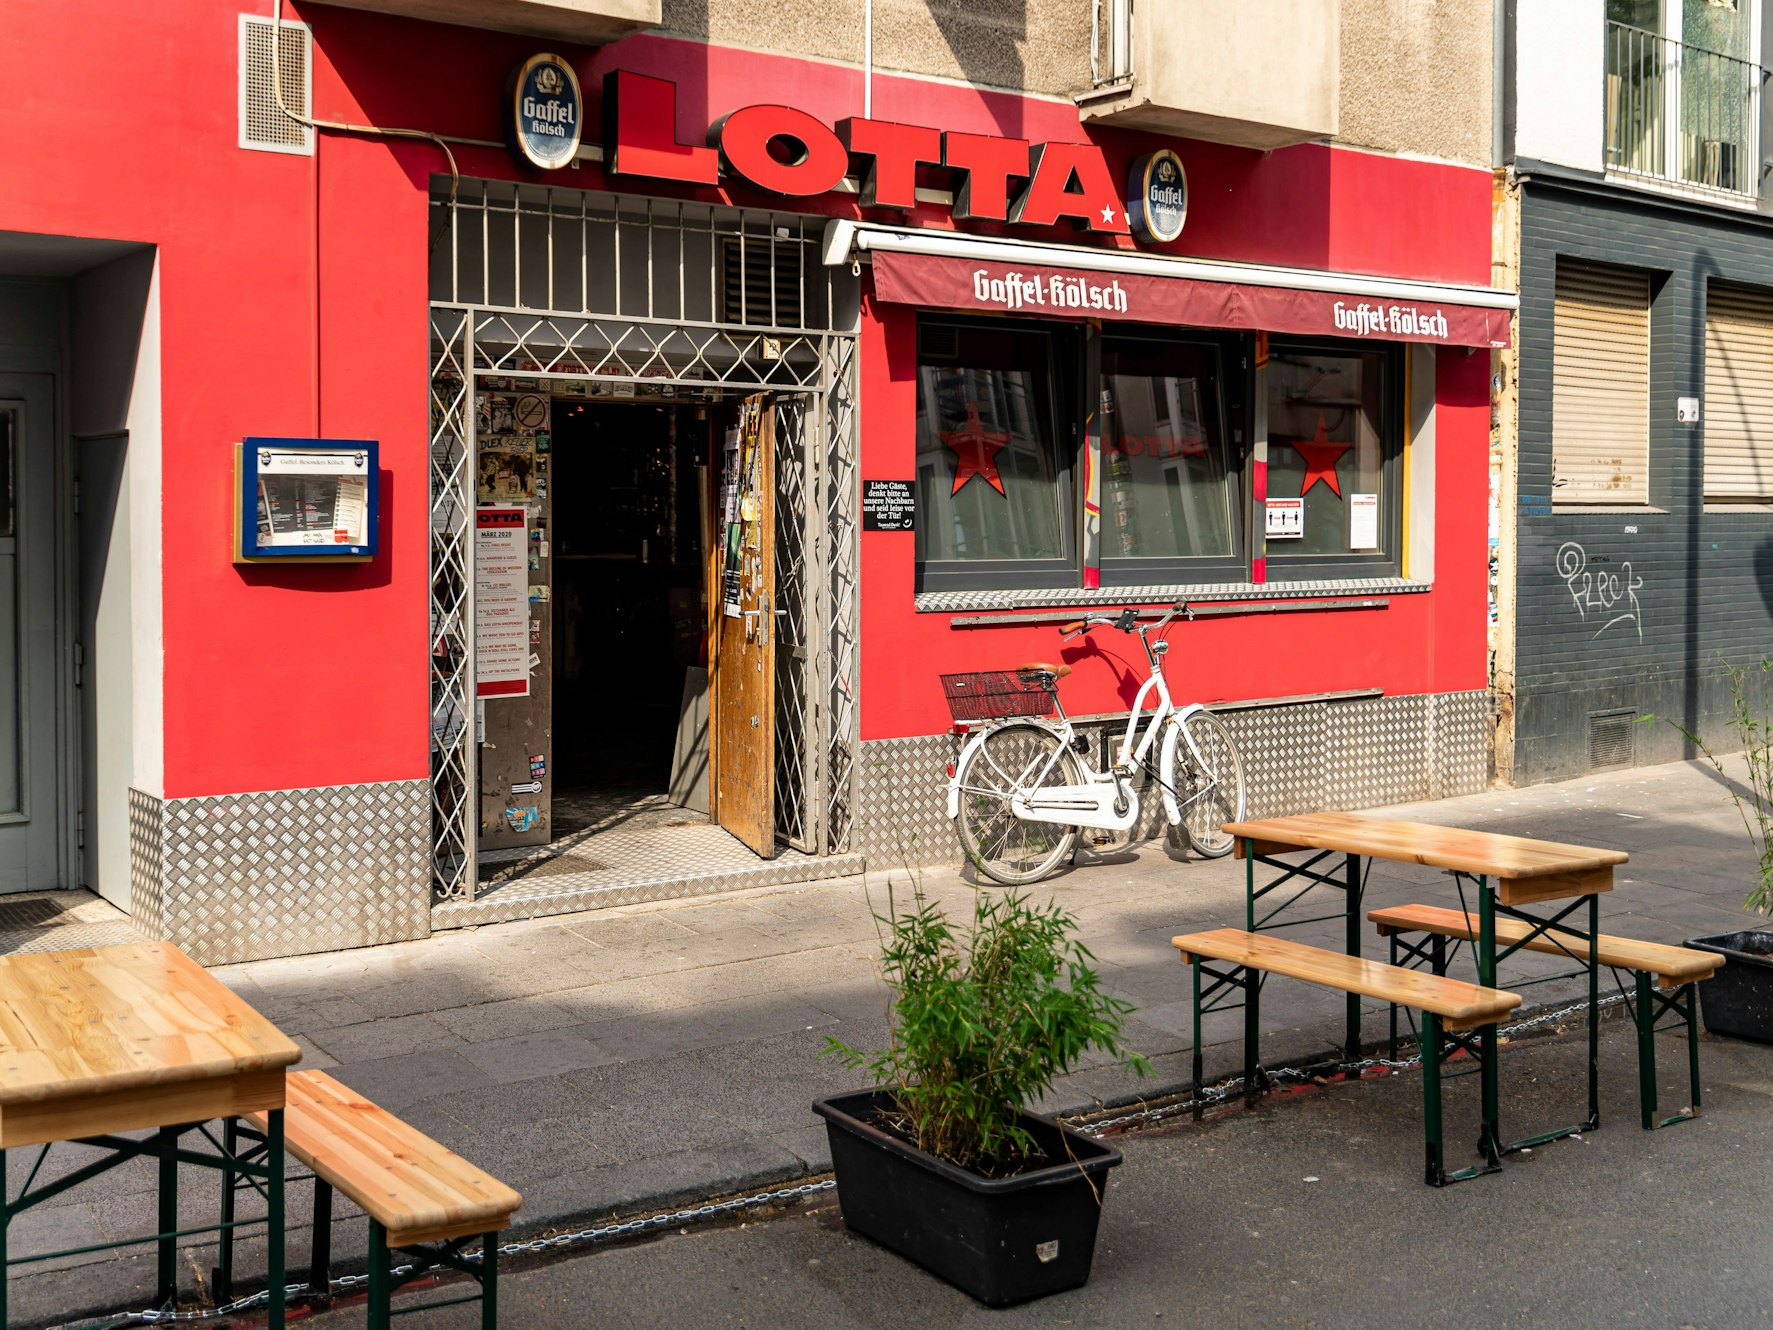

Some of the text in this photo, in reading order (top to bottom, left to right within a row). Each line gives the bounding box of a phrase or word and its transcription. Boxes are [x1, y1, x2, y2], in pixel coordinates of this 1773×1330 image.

[523, 96, 575, 124] Gaffel
[532, 120, 565, 138] Kölsch
[612, 68, 1131, 235] LOTTA
[1150, 184, 1183, 205] Gaffel
[1155, 203, 1177, 216] Kölsch
[973, 269, 1128, 314] Gaffel-Kölsch
[1333, 300, 1448, 339] Gaffel-Kölsch
[889, 482, 907, 490] Gäste,
[868, 489, 887, 497] denkt
[887, 489, 901, 497] bitte
[863, 504, 876, 512] und
[876, 504, 889, 512] seid
[889, 504, 904, 512] leise
[478, 514, 523, 522] OTTA
[888, 511, 902, 519] Tür!
[481, 530, 497, 538] MÄRZ
